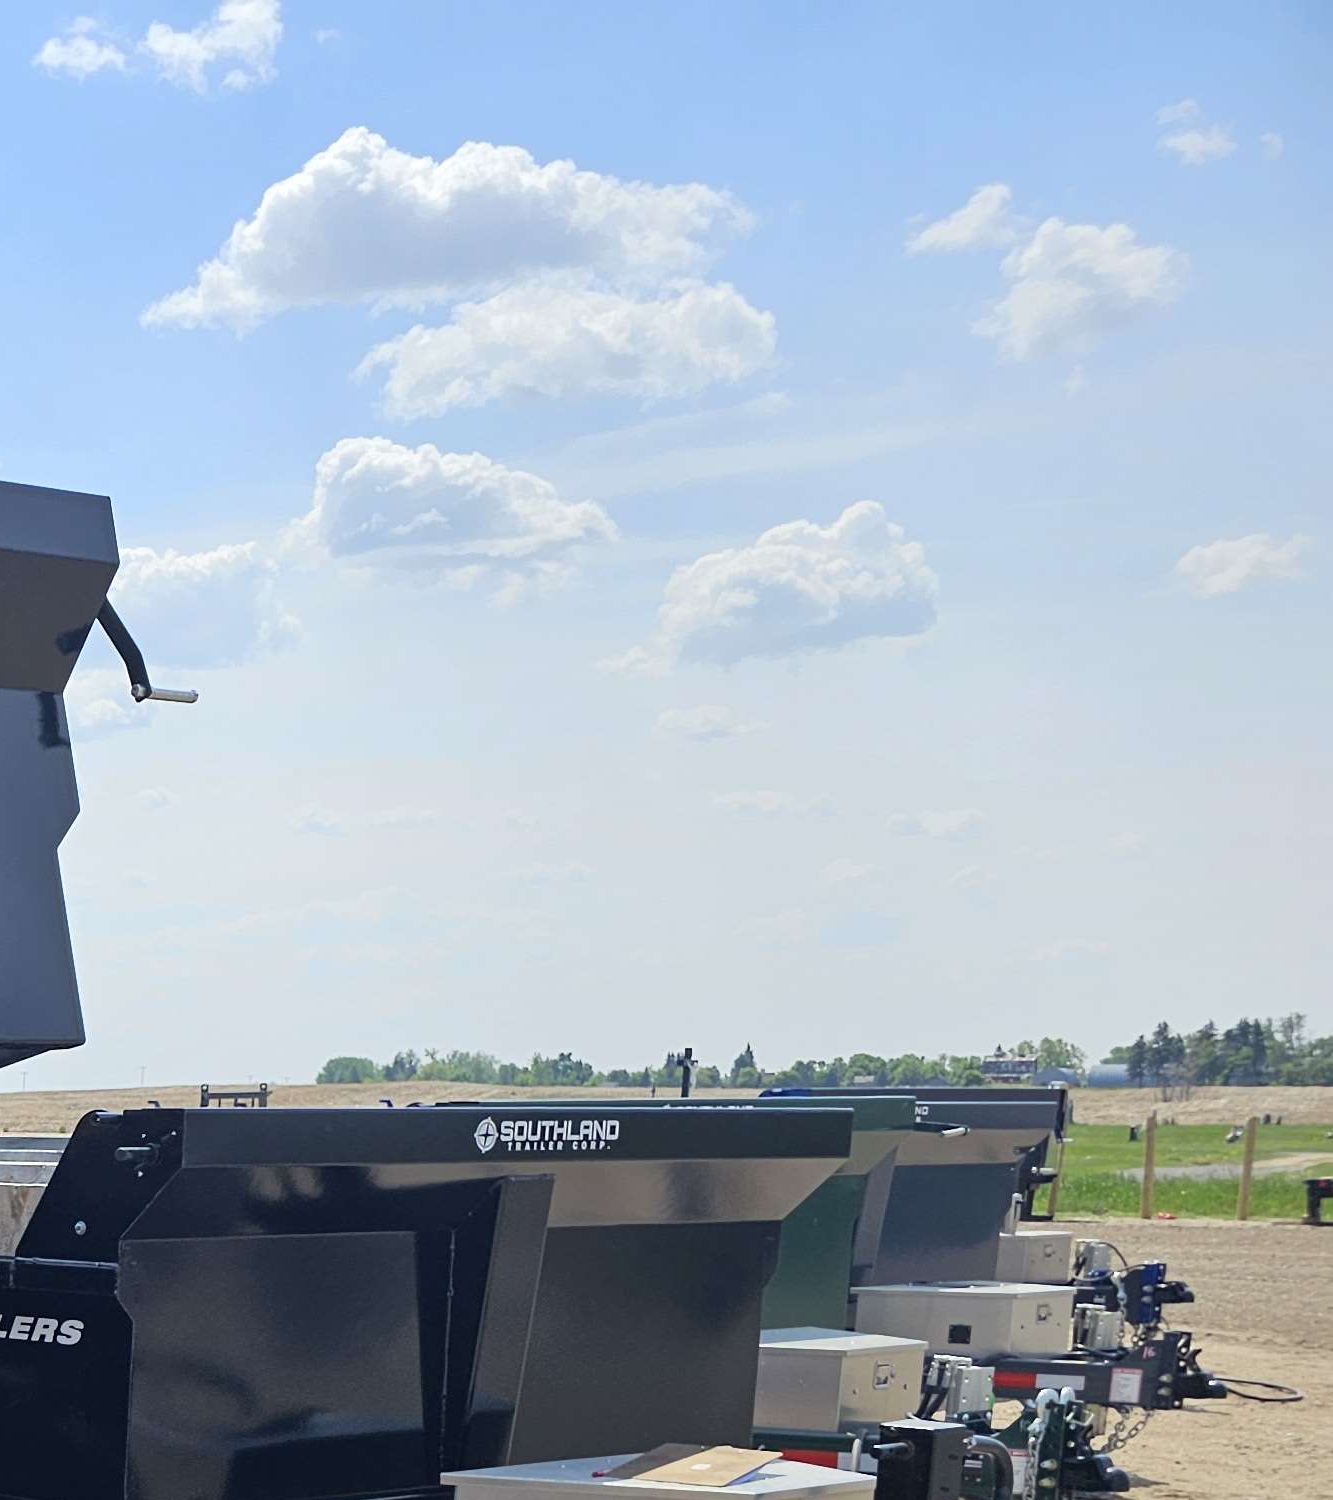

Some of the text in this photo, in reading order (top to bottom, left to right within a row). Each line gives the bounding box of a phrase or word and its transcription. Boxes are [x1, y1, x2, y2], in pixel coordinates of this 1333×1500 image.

[499, 1119, 620, 1141] SOUTHLAND
[507, 1140, 612, 1151] TRAILER CORP.
